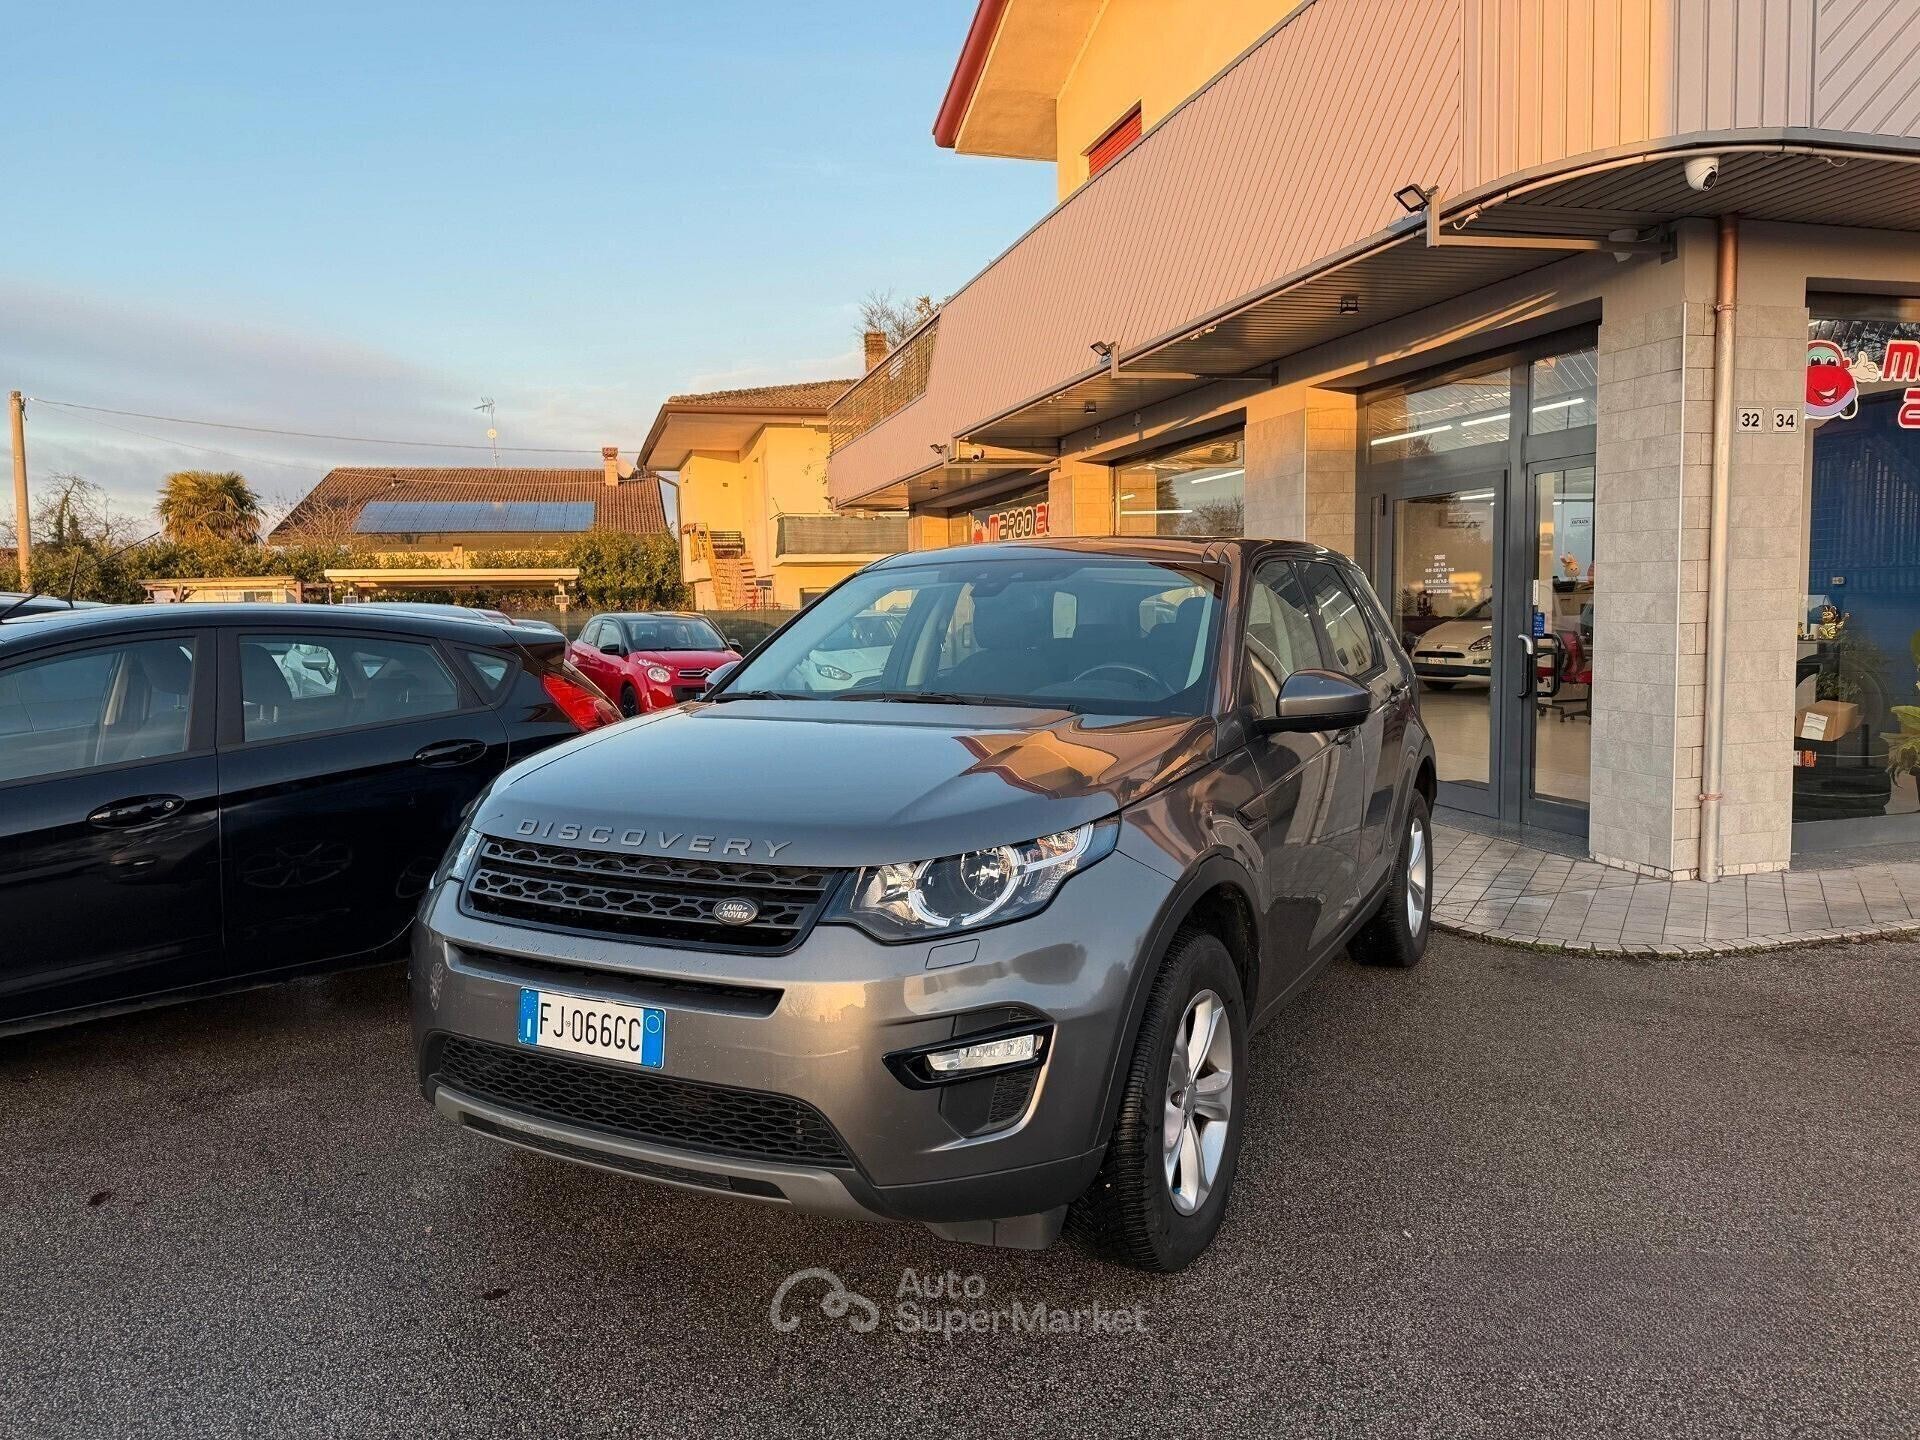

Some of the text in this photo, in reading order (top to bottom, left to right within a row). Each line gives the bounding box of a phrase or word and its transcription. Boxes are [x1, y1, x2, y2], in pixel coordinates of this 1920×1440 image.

[1742, 413, 1760, 427] 32
[1776, 413, 1795, 427] 34
[516, 818, 792, 858] DISCOVERY
[722, 903, 743, 911] LAND
[722, 910, 749, 919] ROVER
[539, 1002, 641, 1051] FJ066GC
